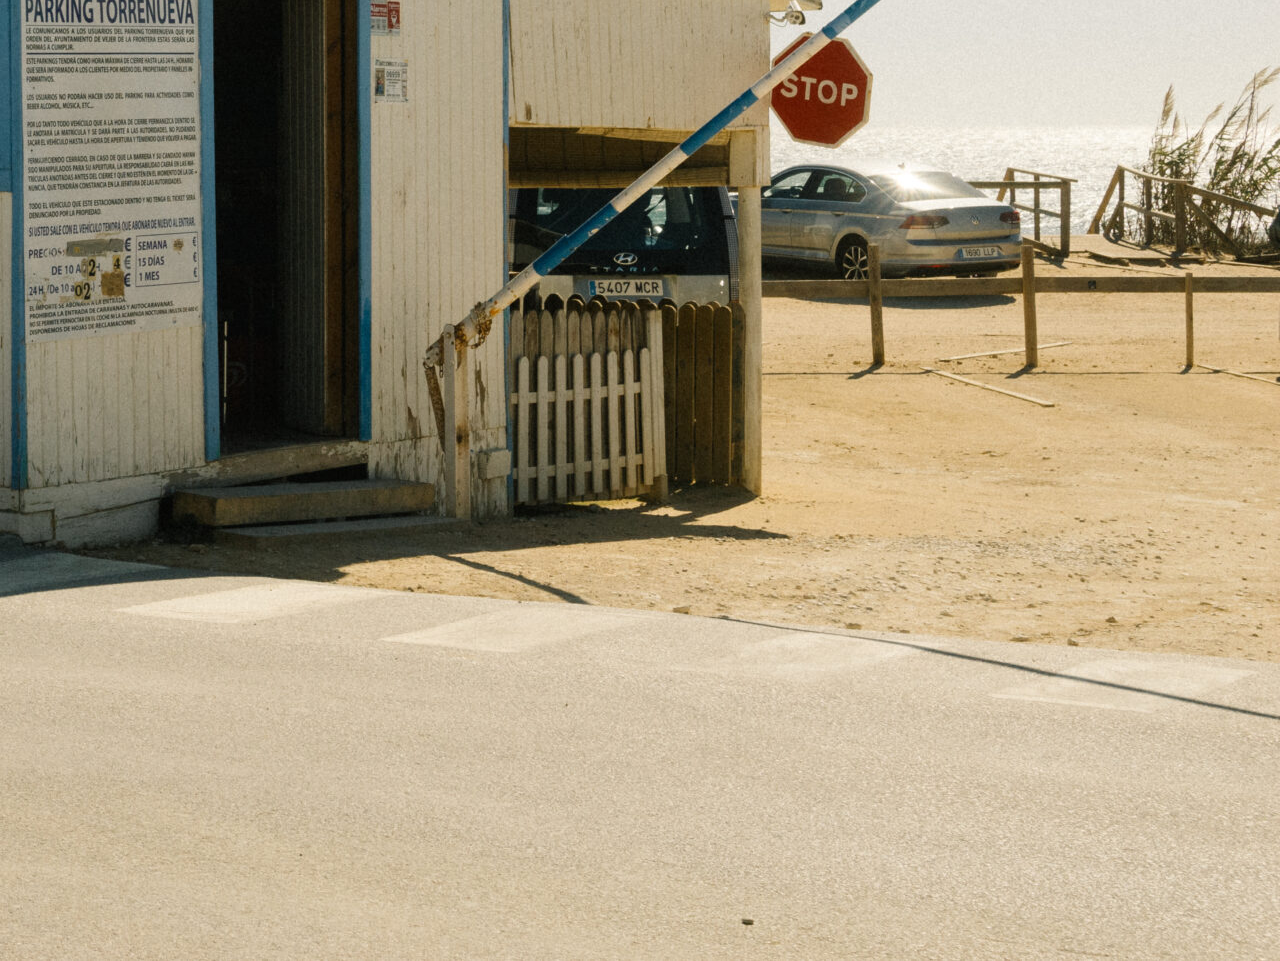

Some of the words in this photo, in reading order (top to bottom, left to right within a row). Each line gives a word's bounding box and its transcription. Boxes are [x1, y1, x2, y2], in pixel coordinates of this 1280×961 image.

[780, 72, 858, 107] STOP
[34, 225, 49, 237] USTED
[50, 224, 61, 236] SALE
[62, 224, 72, 235] CON
[73, 223, 78, 234] EL
[124, 238, 132, 252] €
[138, 240, 168, 250] SEMANA
[966, 248, 980, 256] 1690
[984, 248, 995, 256] LLP
[52, 266, 62, 275] DE
[65, 264, 74, 274] 10
[76, 264, 82, 274] A
[114, 257, 120, 270] 4
[124, 255, 132, 270] €
[138, 258, 146, 267] 15
[148, 255, 165, 266] DÍAS
[139, 272, 142, 282] 1
[144, 270, 160, 281] MES
[29, 286, 38, 296] 24
[61, 283, 70, 294] 10
[124, 272, 131, 288] €
[598, 282, 630, 294] 5407
[635, 282, 660, 294] MCR
